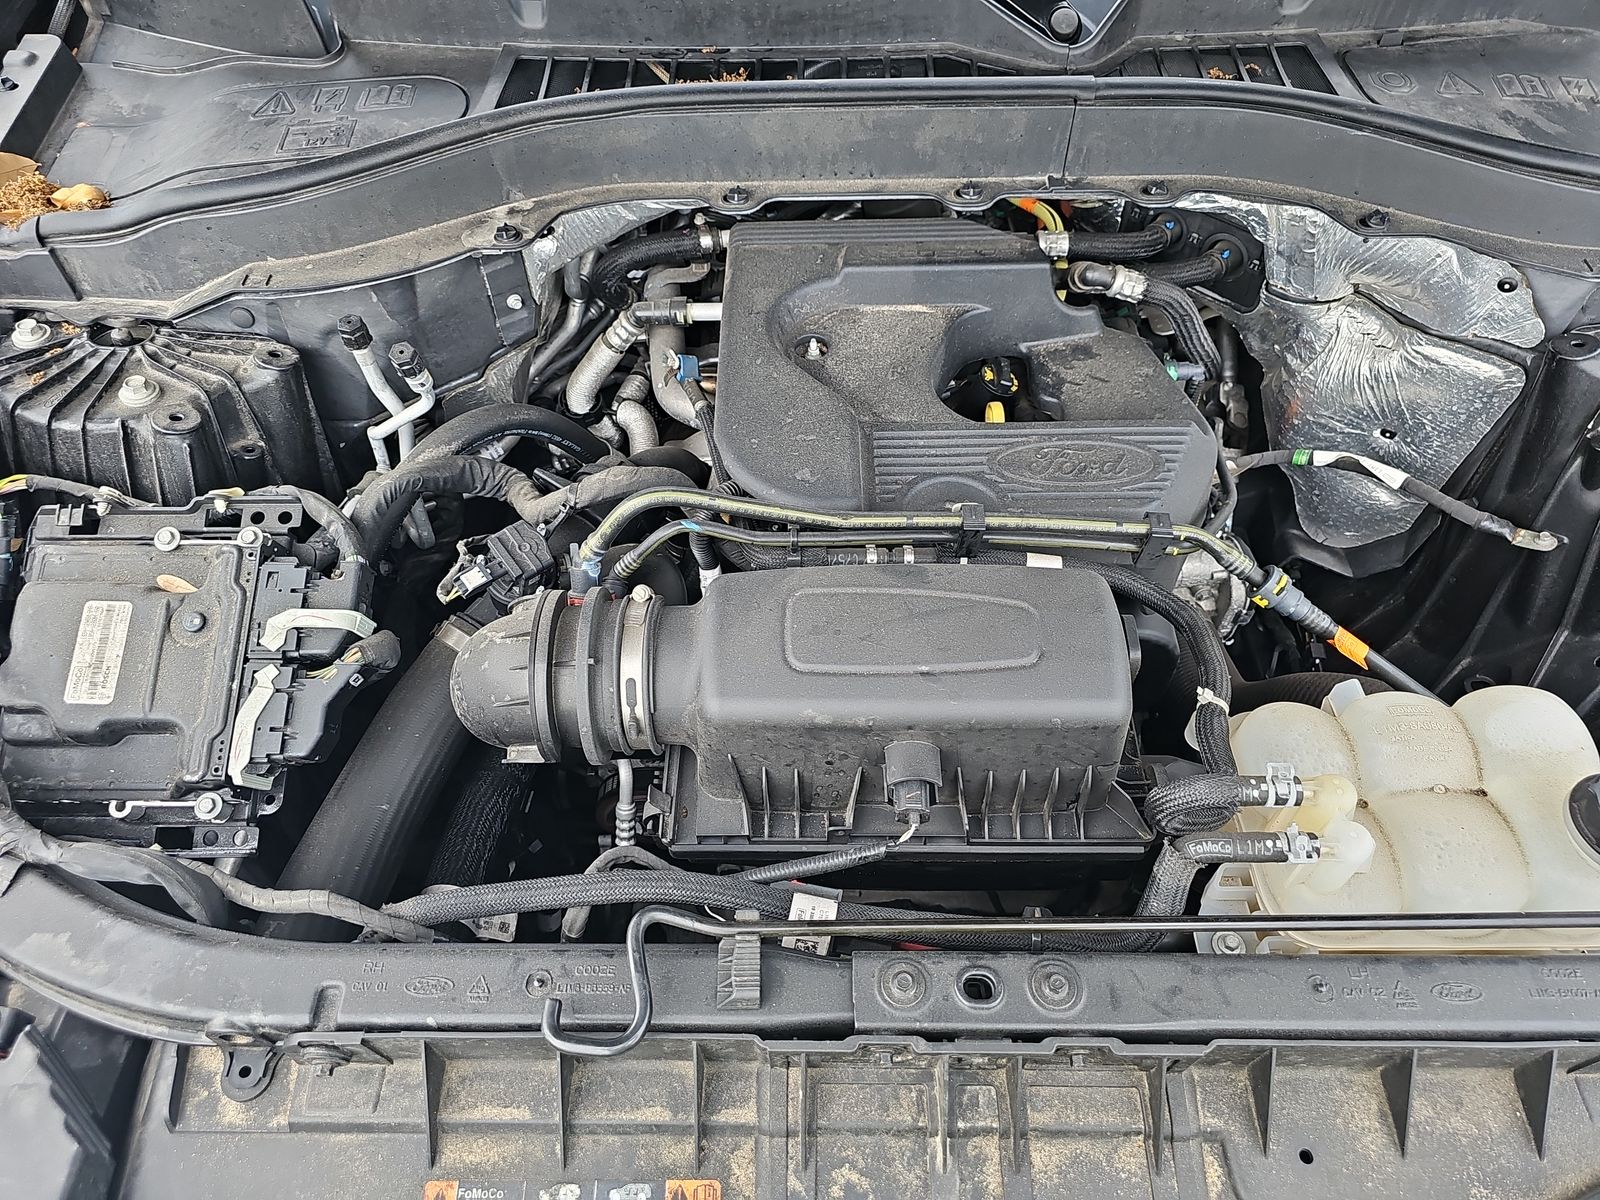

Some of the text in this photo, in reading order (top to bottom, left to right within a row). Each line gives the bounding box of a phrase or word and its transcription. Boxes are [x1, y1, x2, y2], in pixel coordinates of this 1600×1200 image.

[1029, 447, 1128, 478] Ford
[1190, 841, 1232, 855] FoMoCo
[363, 961, 385, 975] RH
[1346, 965, 1370, 979] LH
[458, 1187, 504, 1199] FoMoCo
